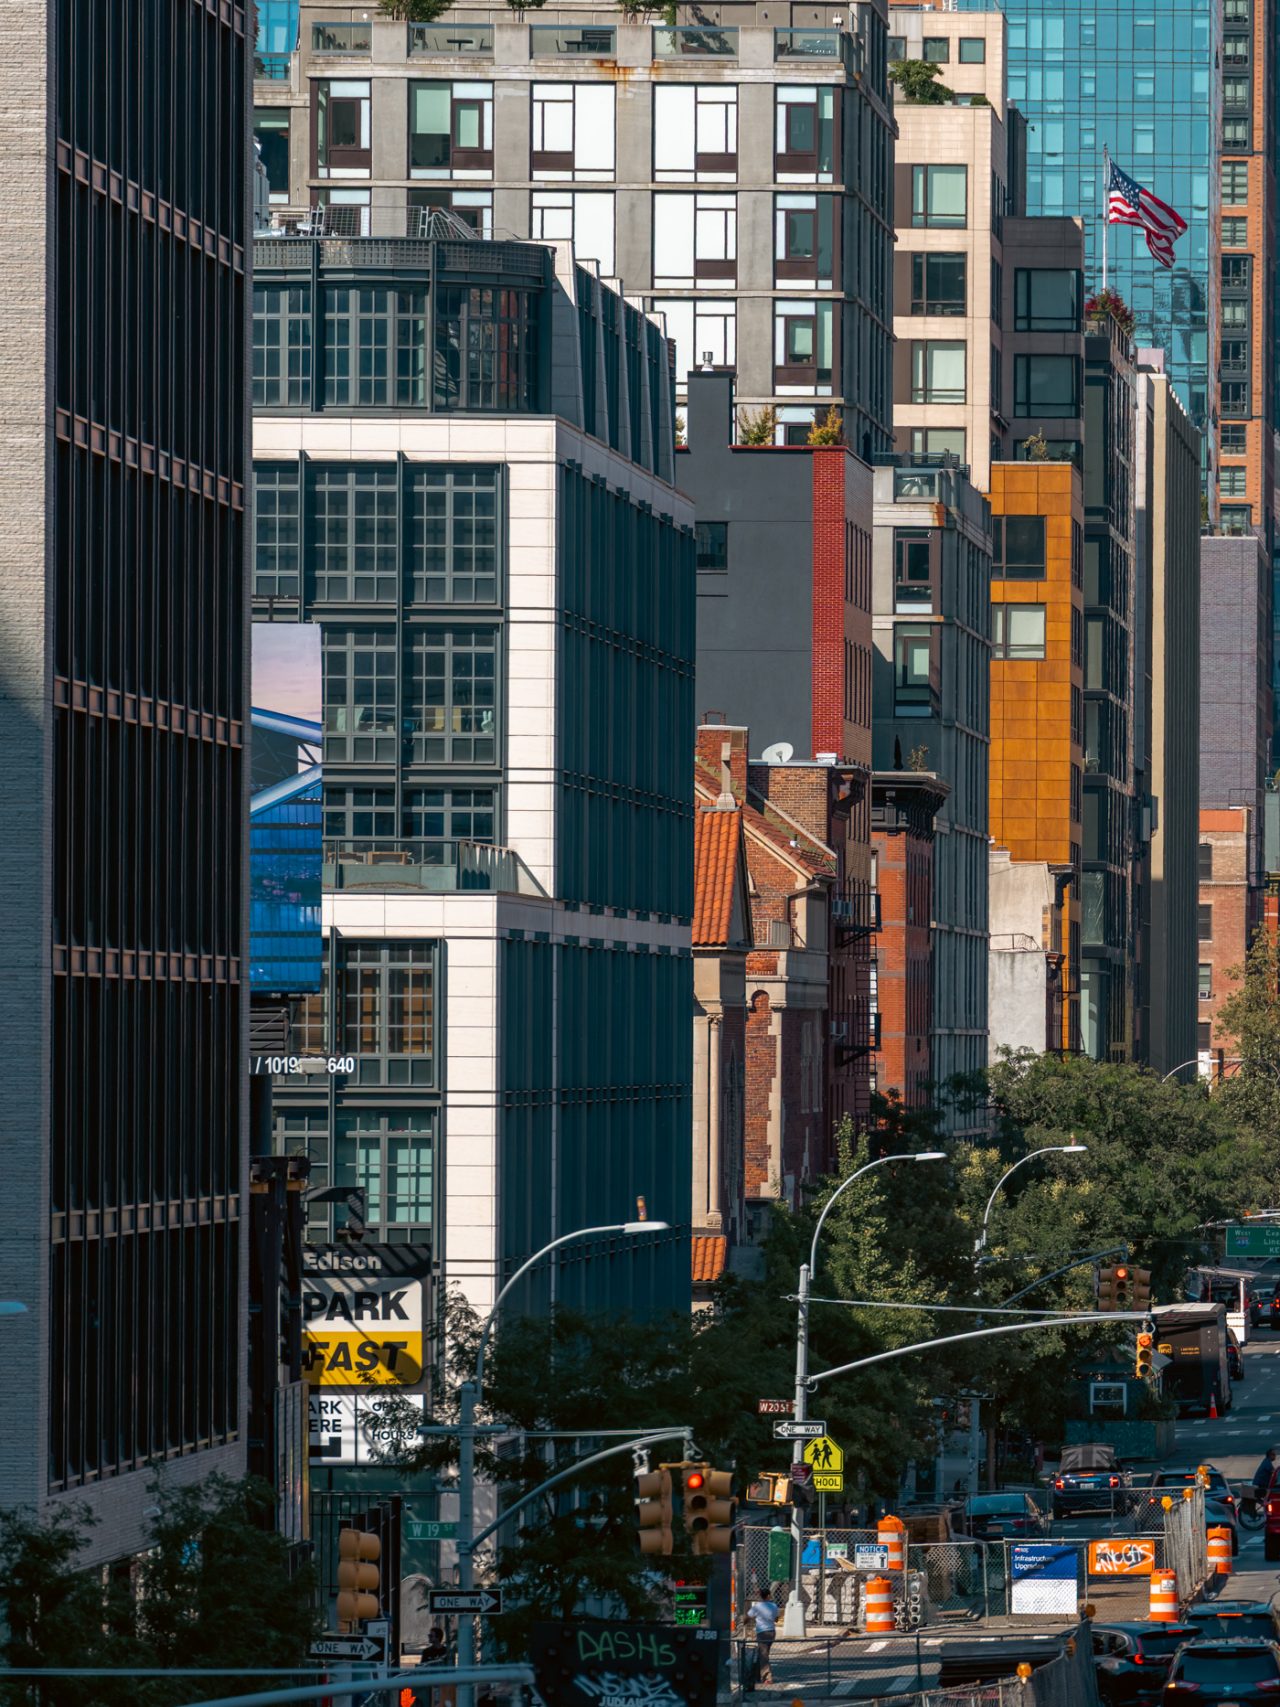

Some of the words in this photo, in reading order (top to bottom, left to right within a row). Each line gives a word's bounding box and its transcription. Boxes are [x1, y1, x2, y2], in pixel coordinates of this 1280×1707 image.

[303, 1251, 381, 1270] Edison
[303, 1291, 409, 1321] PARK
[304, 1340, 408, 1371] FAST
[308, 1401, 342, 1415] ARK
[309, 1419, 342, 1433] ERE
[372, 1430, 414, 1440] HOURS
[815, 1478, 840, 1487] HOOL
[411, 1523, 423, 1537] W
[427, 1523, 440, 1537] 19
[439, 1597, 460, 1607] ONE
[469, 1597, 490, 1607] WAY
[316, 1642, 339, 1654] ONE
[350, 1641, 374, 1654] WAY
